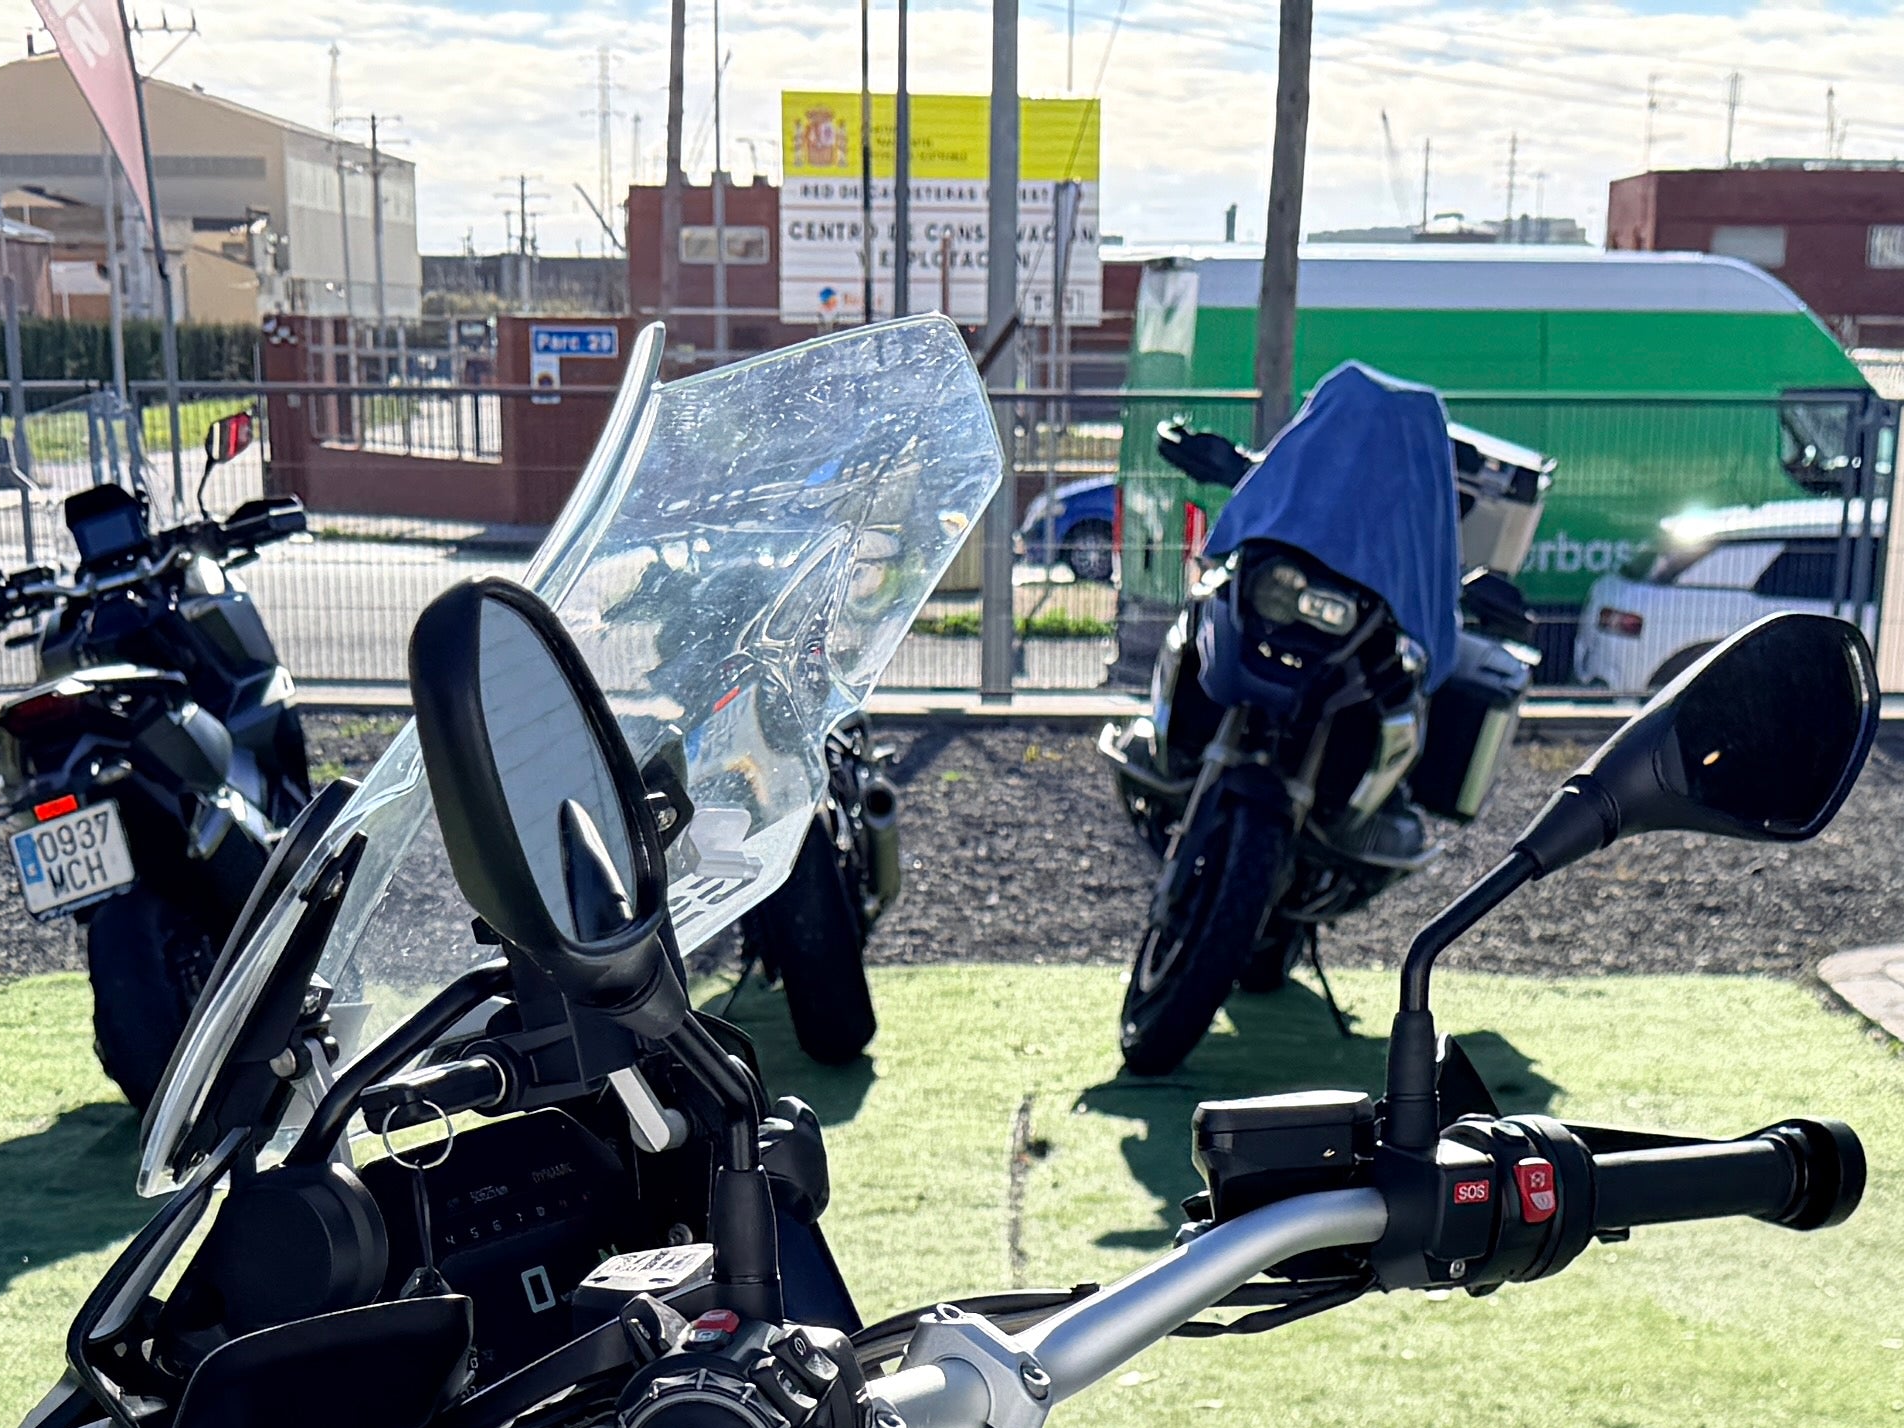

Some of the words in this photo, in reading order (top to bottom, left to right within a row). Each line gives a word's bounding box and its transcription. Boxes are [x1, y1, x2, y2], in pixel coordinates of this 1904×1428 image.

[36, 810, 110, 863] 0937
[1458, 1184, 1486, 1201] SOS
[520, 1264, 557, 1315] 0
